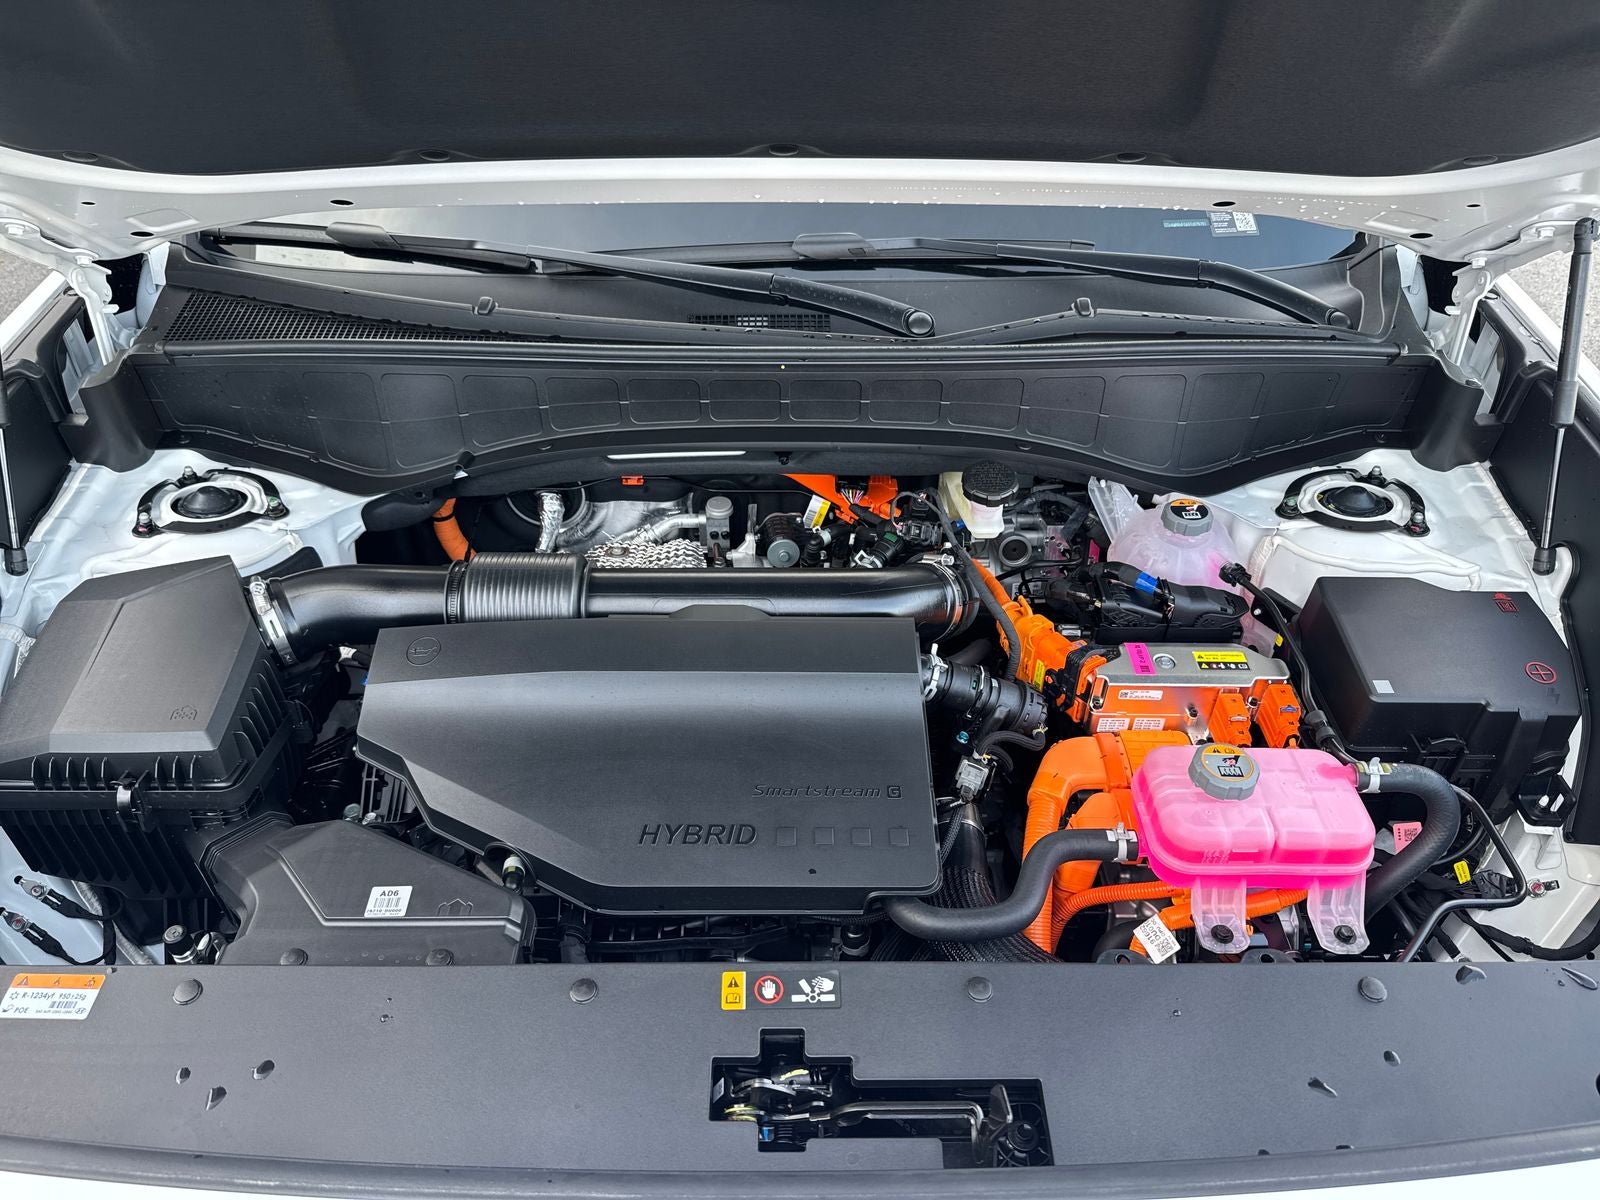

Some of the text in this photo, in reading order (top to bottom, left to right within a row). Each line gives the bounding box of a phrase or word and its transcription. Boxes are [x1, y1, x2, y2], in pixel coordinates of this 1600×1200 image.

[752, 785, 902, 799] Smartstream G
[638, 824, 758, 846] HYBRID
[380, 889, 400, 897] AD6
